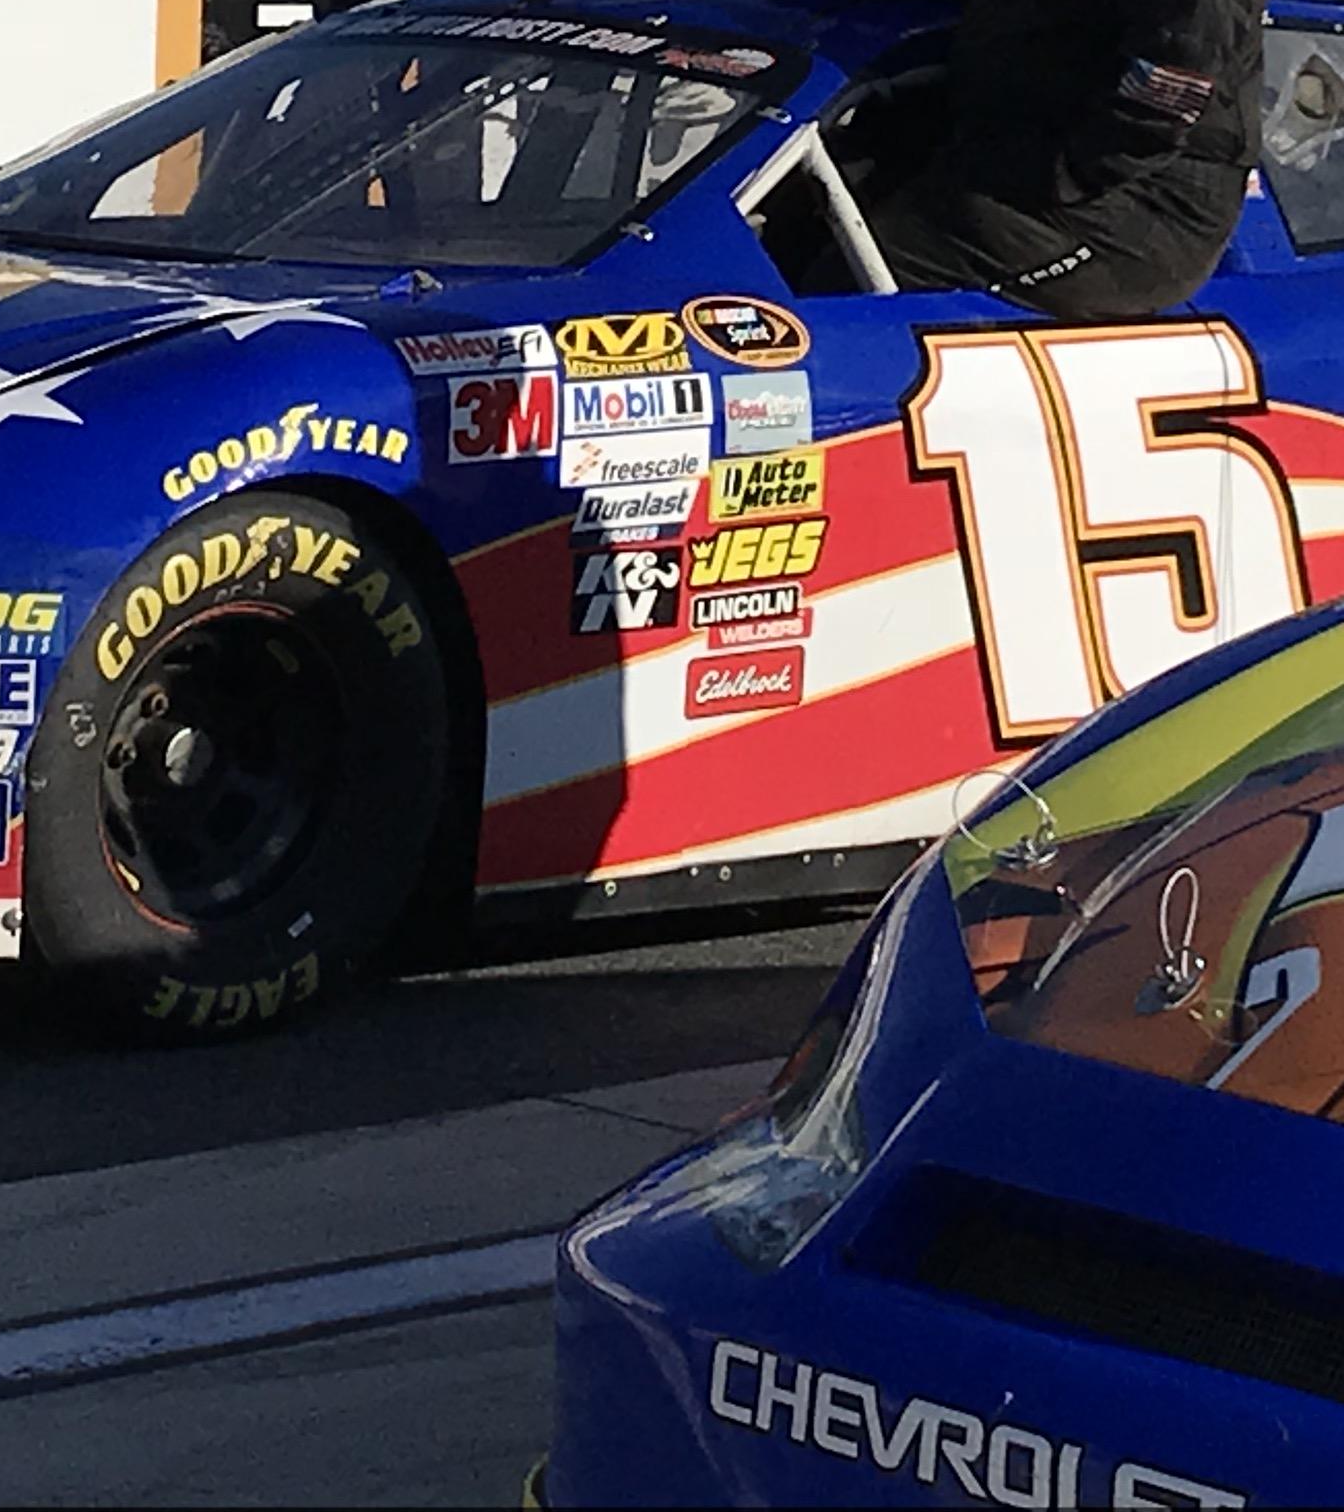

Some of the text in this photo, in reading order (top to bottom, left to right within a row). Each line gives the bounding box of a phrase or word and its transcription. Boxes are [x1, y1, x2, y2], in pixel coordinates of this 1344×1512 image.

[401, 333, 498, 368] Holley
[645, 350, 692, 374] WEAR
[453, 376, 554, 457] 3M
[573, 380, 664, 422] Mobil
[674, 378, 701, 414] 1
[163, 402, 409, 502] GOODYEAR
[601, 452, 699, 482] freescale
[747, 458, 807, 484] Auto
[581, 489, 689, 524] Duralast
[740, 482, 818, 512] Meter
[903, 318, 1310, 746] 15
[689, 520, 827, 587] JEGS
[97, 516, 423, 680] GOODYEAR
[697, 589, 794, 625] LINCOLN
[721, 618, 804, 644] WELDERS
[696, 664, 792, 703] Edelbrock
